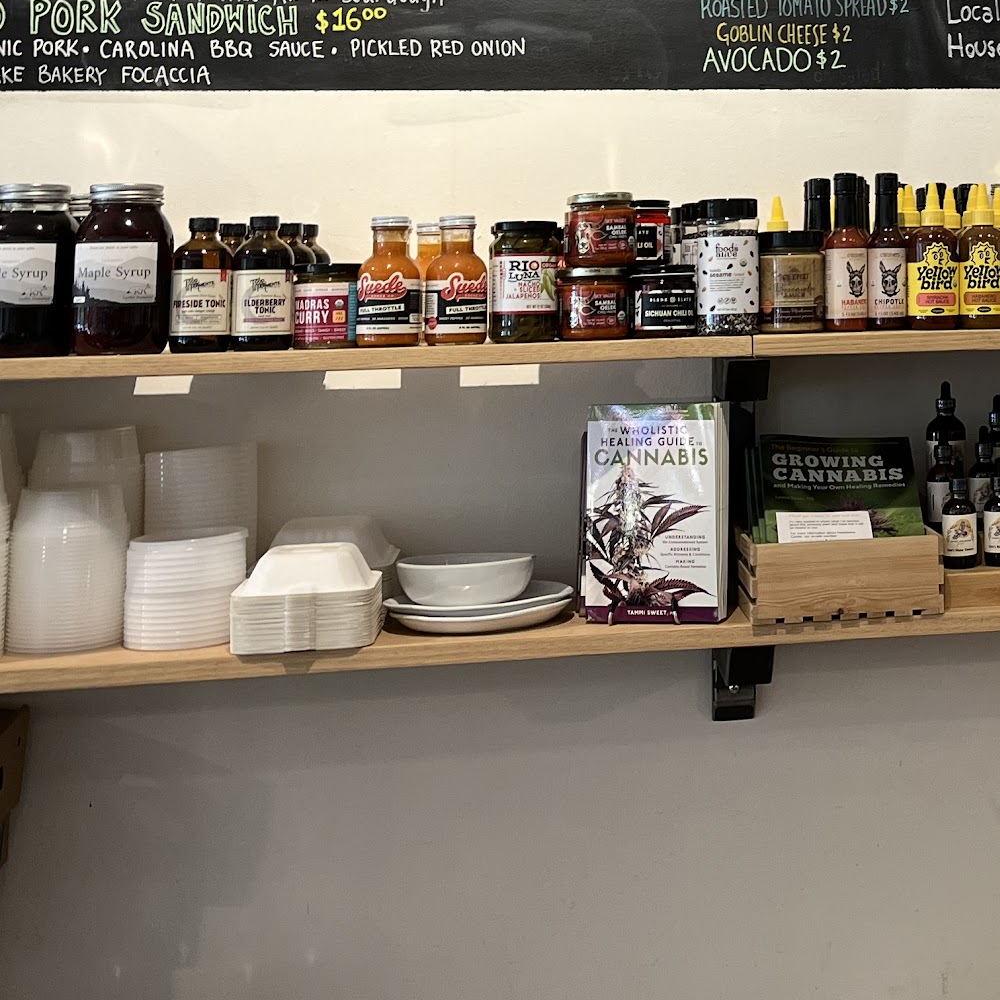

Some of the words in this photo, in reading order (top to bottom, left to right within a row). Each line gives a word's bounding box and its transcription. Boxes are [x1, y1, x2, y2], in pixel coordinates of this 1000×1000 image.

[140, 1, 300, 37] SANDWICH
[32, 39, 79, 58] PORK
[99, 39, 195, 60] CAROLINA
[209, 39, 254, 60] BBQ
[268, 40, 325, 60] SAUCE
[349, 38, 423, 58] PICKLED
[429, 38, 465, 59] RED
[470, 37, 527, 57] ONION
[702, 46, 812, 74] AVOCADO
[814, 48, 847, 73] $2
[11, 266, 49, 281] Syrup
[508, 260, 540, 272] RIO
[77, 266, 111, 281] Maple
[115, 266, 152, 282] Syrup
[508, 271, 541, 281] LUNA
[920, 278, 953, 290] bird
[254, 306, 276, 314] TONIC
[294, 310, 330, 325] CURRY
[619, 425, 687, 436] WHOLISTIC
[600, 437, 652, 447] HEALING
[657, 437, 695, 446] GUIDE
[593, 448, 709, 466] CANNABIS
[771, 453, 884, 468] GROWING
[772, 468, 904, 483] CANNABIS
[787, 482, 812, 491] Making
[846, 483, 872, 491] Healing
